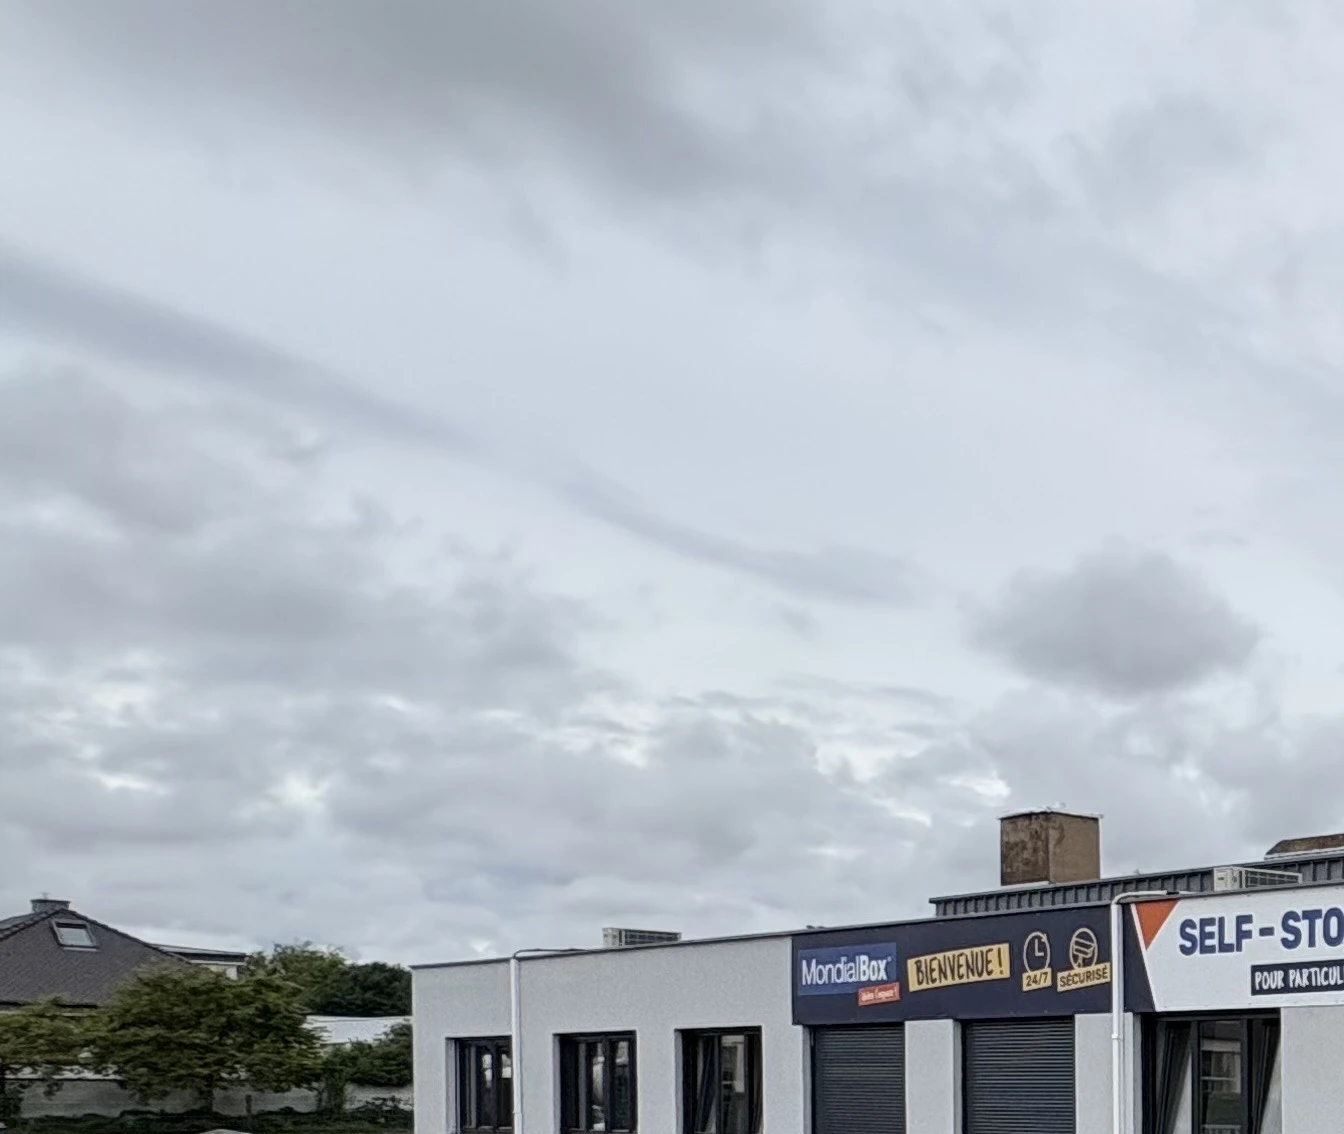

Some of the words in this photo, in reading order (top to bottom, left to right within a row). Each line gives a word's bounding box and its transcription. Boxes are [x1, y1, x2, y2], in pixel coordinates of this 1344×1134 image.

[914, 947, 995, 987] BIENVENUE
[1059, 966, 1109, 988] SÉCURISÉ
[1025, 972, 1049, 988] 24/7
[1254, 970, 1285, 991] POUR
